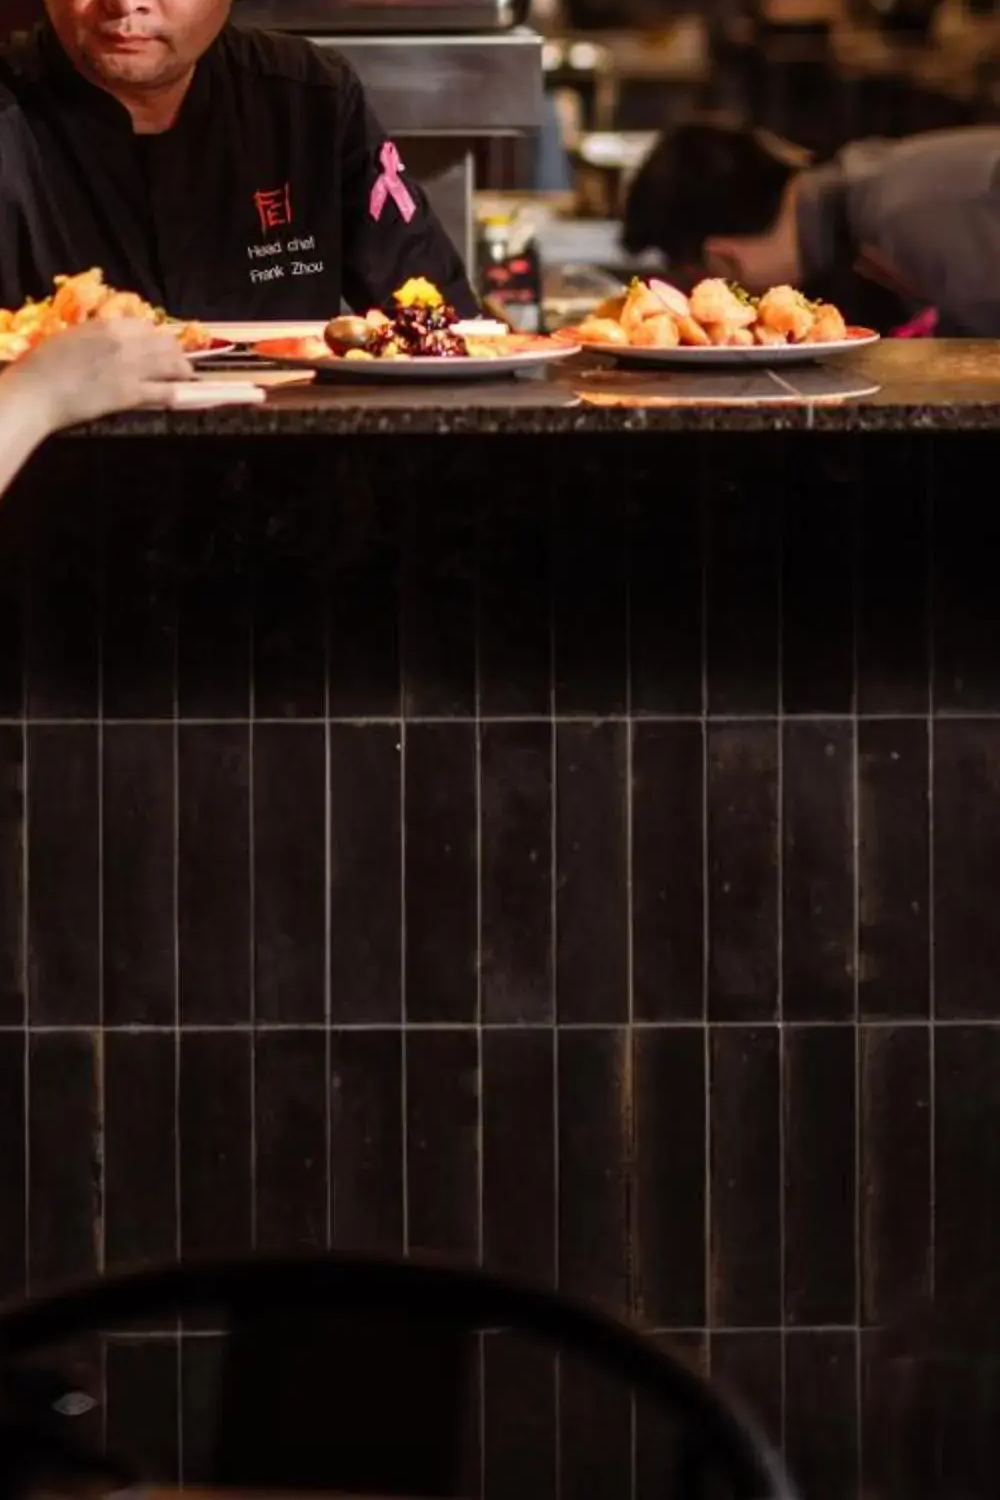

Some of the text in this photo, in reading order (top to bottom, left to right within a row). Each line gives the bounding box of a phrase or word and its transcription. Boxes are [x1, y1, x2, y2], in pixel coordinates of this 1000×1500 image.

[247, 235, 315, 259] Head chef
[250, 260, 324, 283] Frank Zhou
